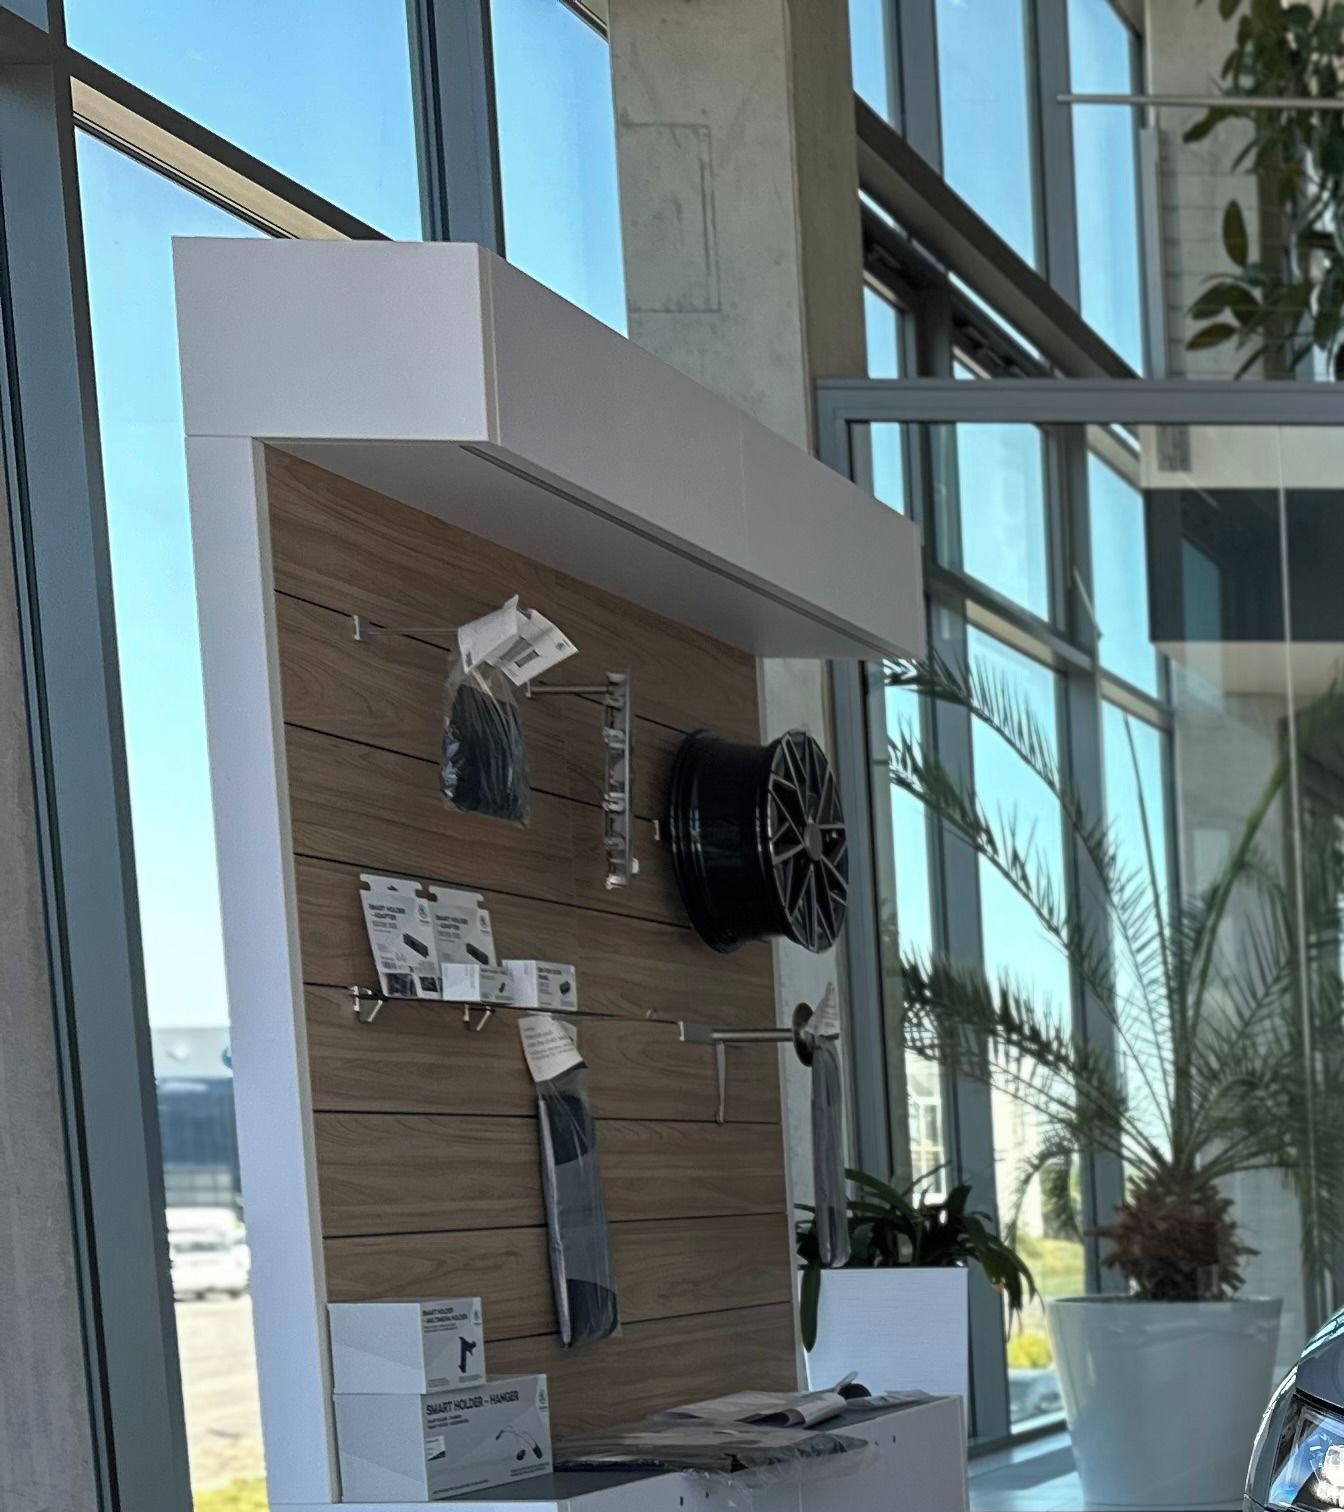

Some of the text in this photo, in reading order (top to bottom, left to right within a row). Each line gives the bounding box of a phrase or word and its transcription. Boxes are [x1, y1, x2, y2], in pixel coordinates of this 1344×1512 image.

[426, 1400, 452, 1416] SMART
[453, 1395, 484, 1411] HOLDER
[489, 1390, 520, 1406] HANGER
